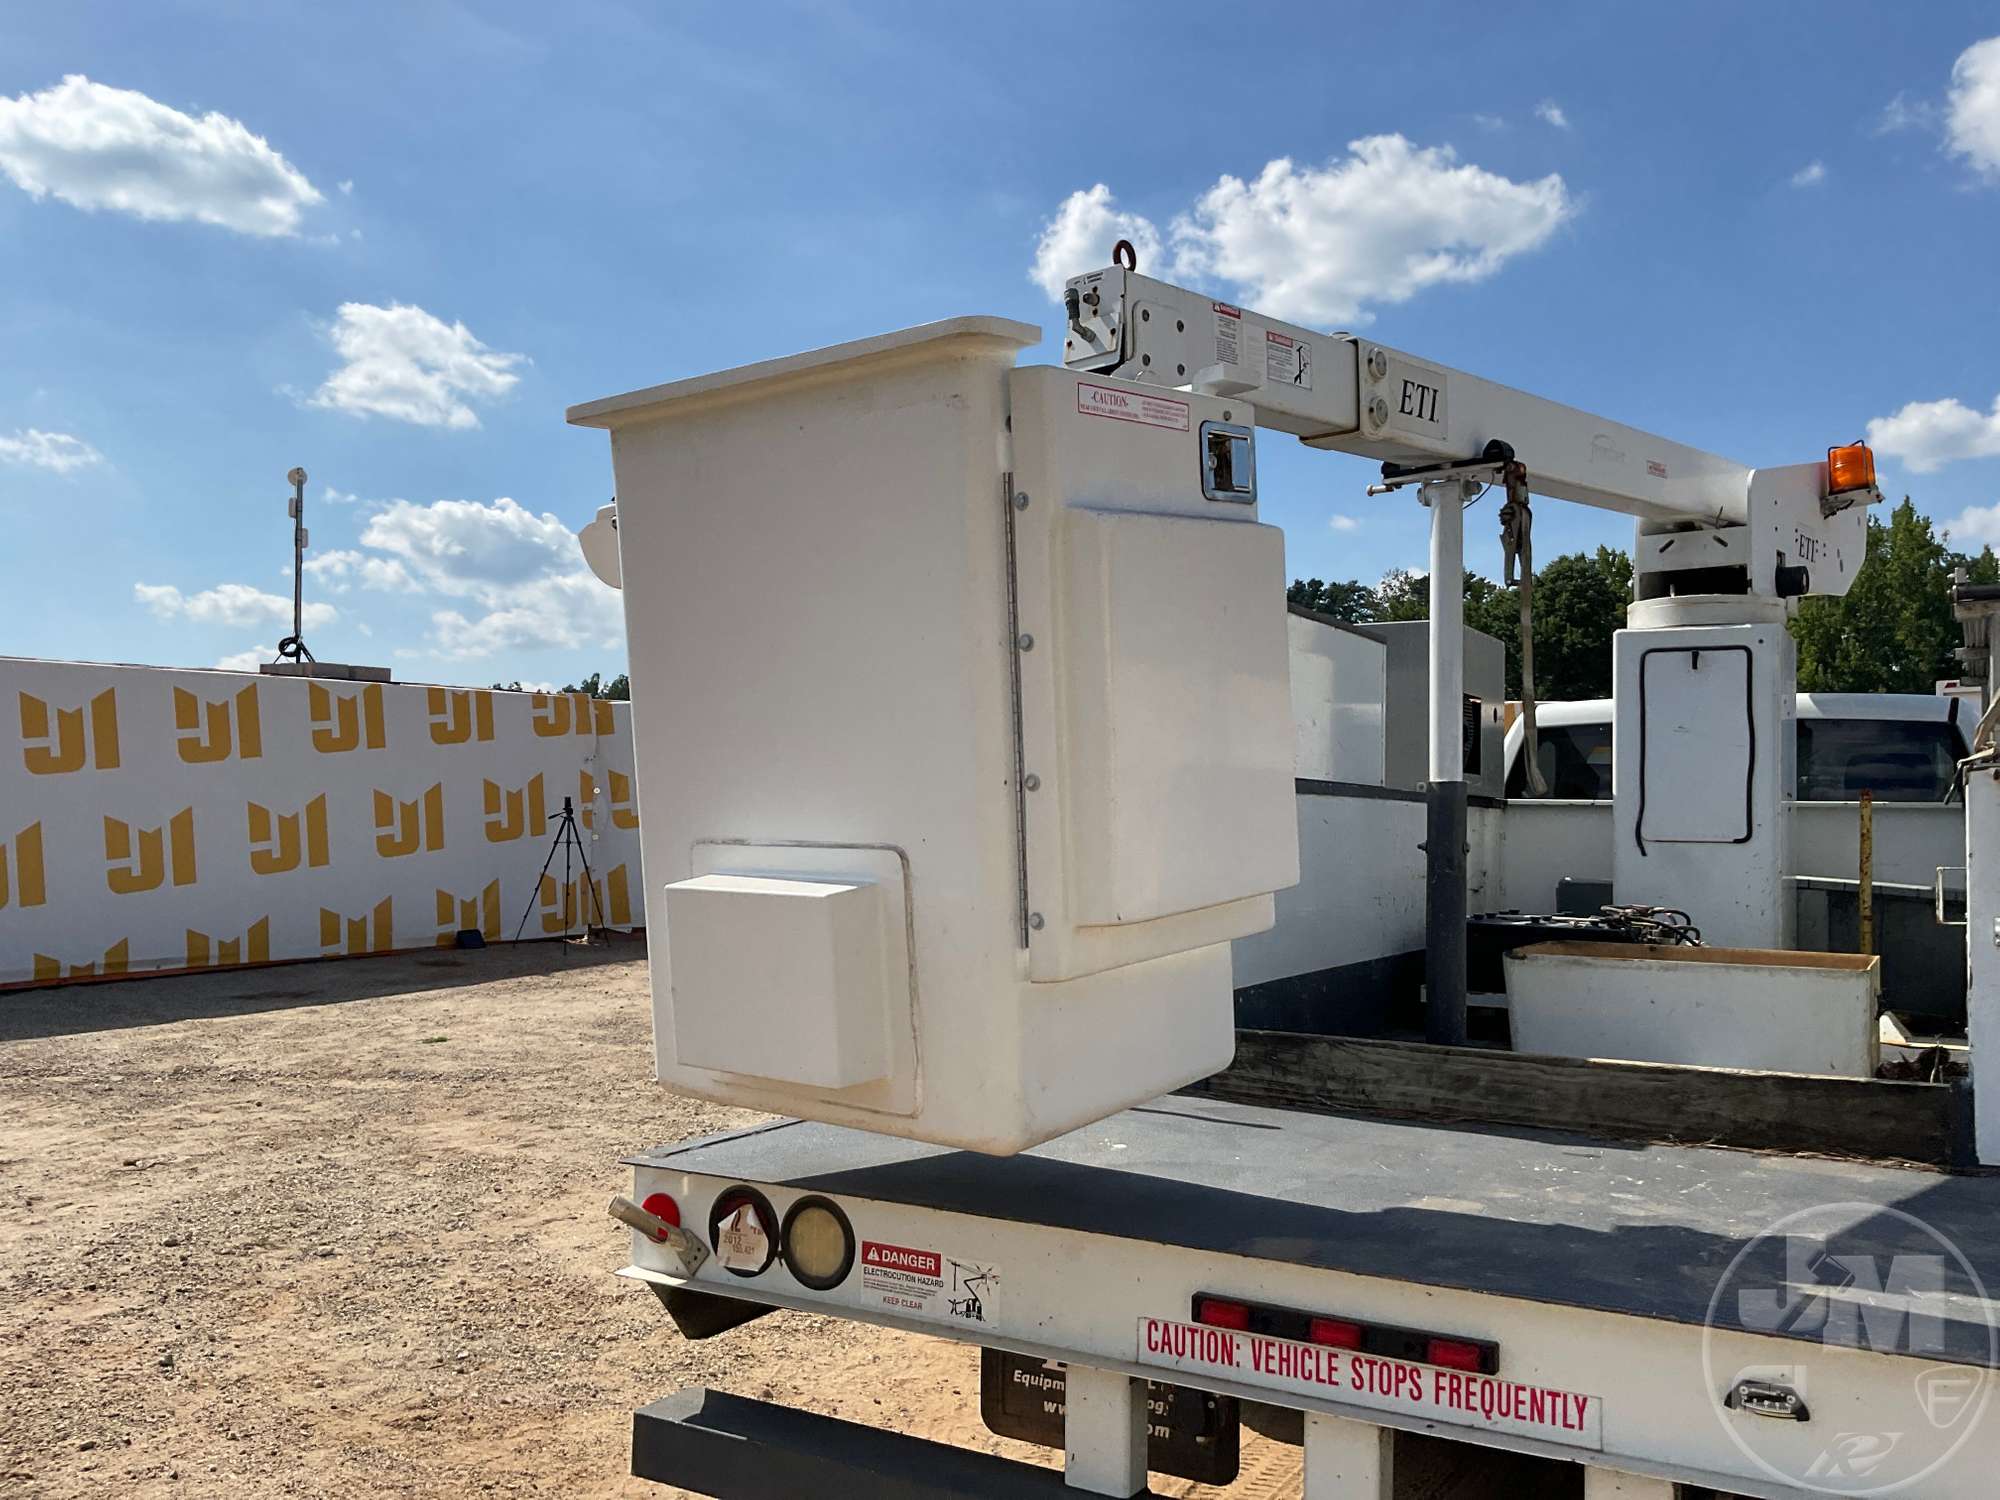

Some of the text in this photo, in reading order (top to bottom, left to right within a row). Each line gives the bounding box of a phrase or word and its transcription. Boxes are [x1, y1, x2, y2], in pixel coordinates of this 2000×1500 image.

[1399, 379, 1438, 423] ETI
[882, 1250, 935, 1271] DANGER
[864, 1266, 944, 1288] ELECTROCUTION HAZARD
[882, 1296, 923, 1310] KEEP CLEAR
[1013, 1370, 1066, 1391] Equipm
[1146, 1320, 1588, 1431] CAUTION: VEHICLE STOPS FREQUENTLY
